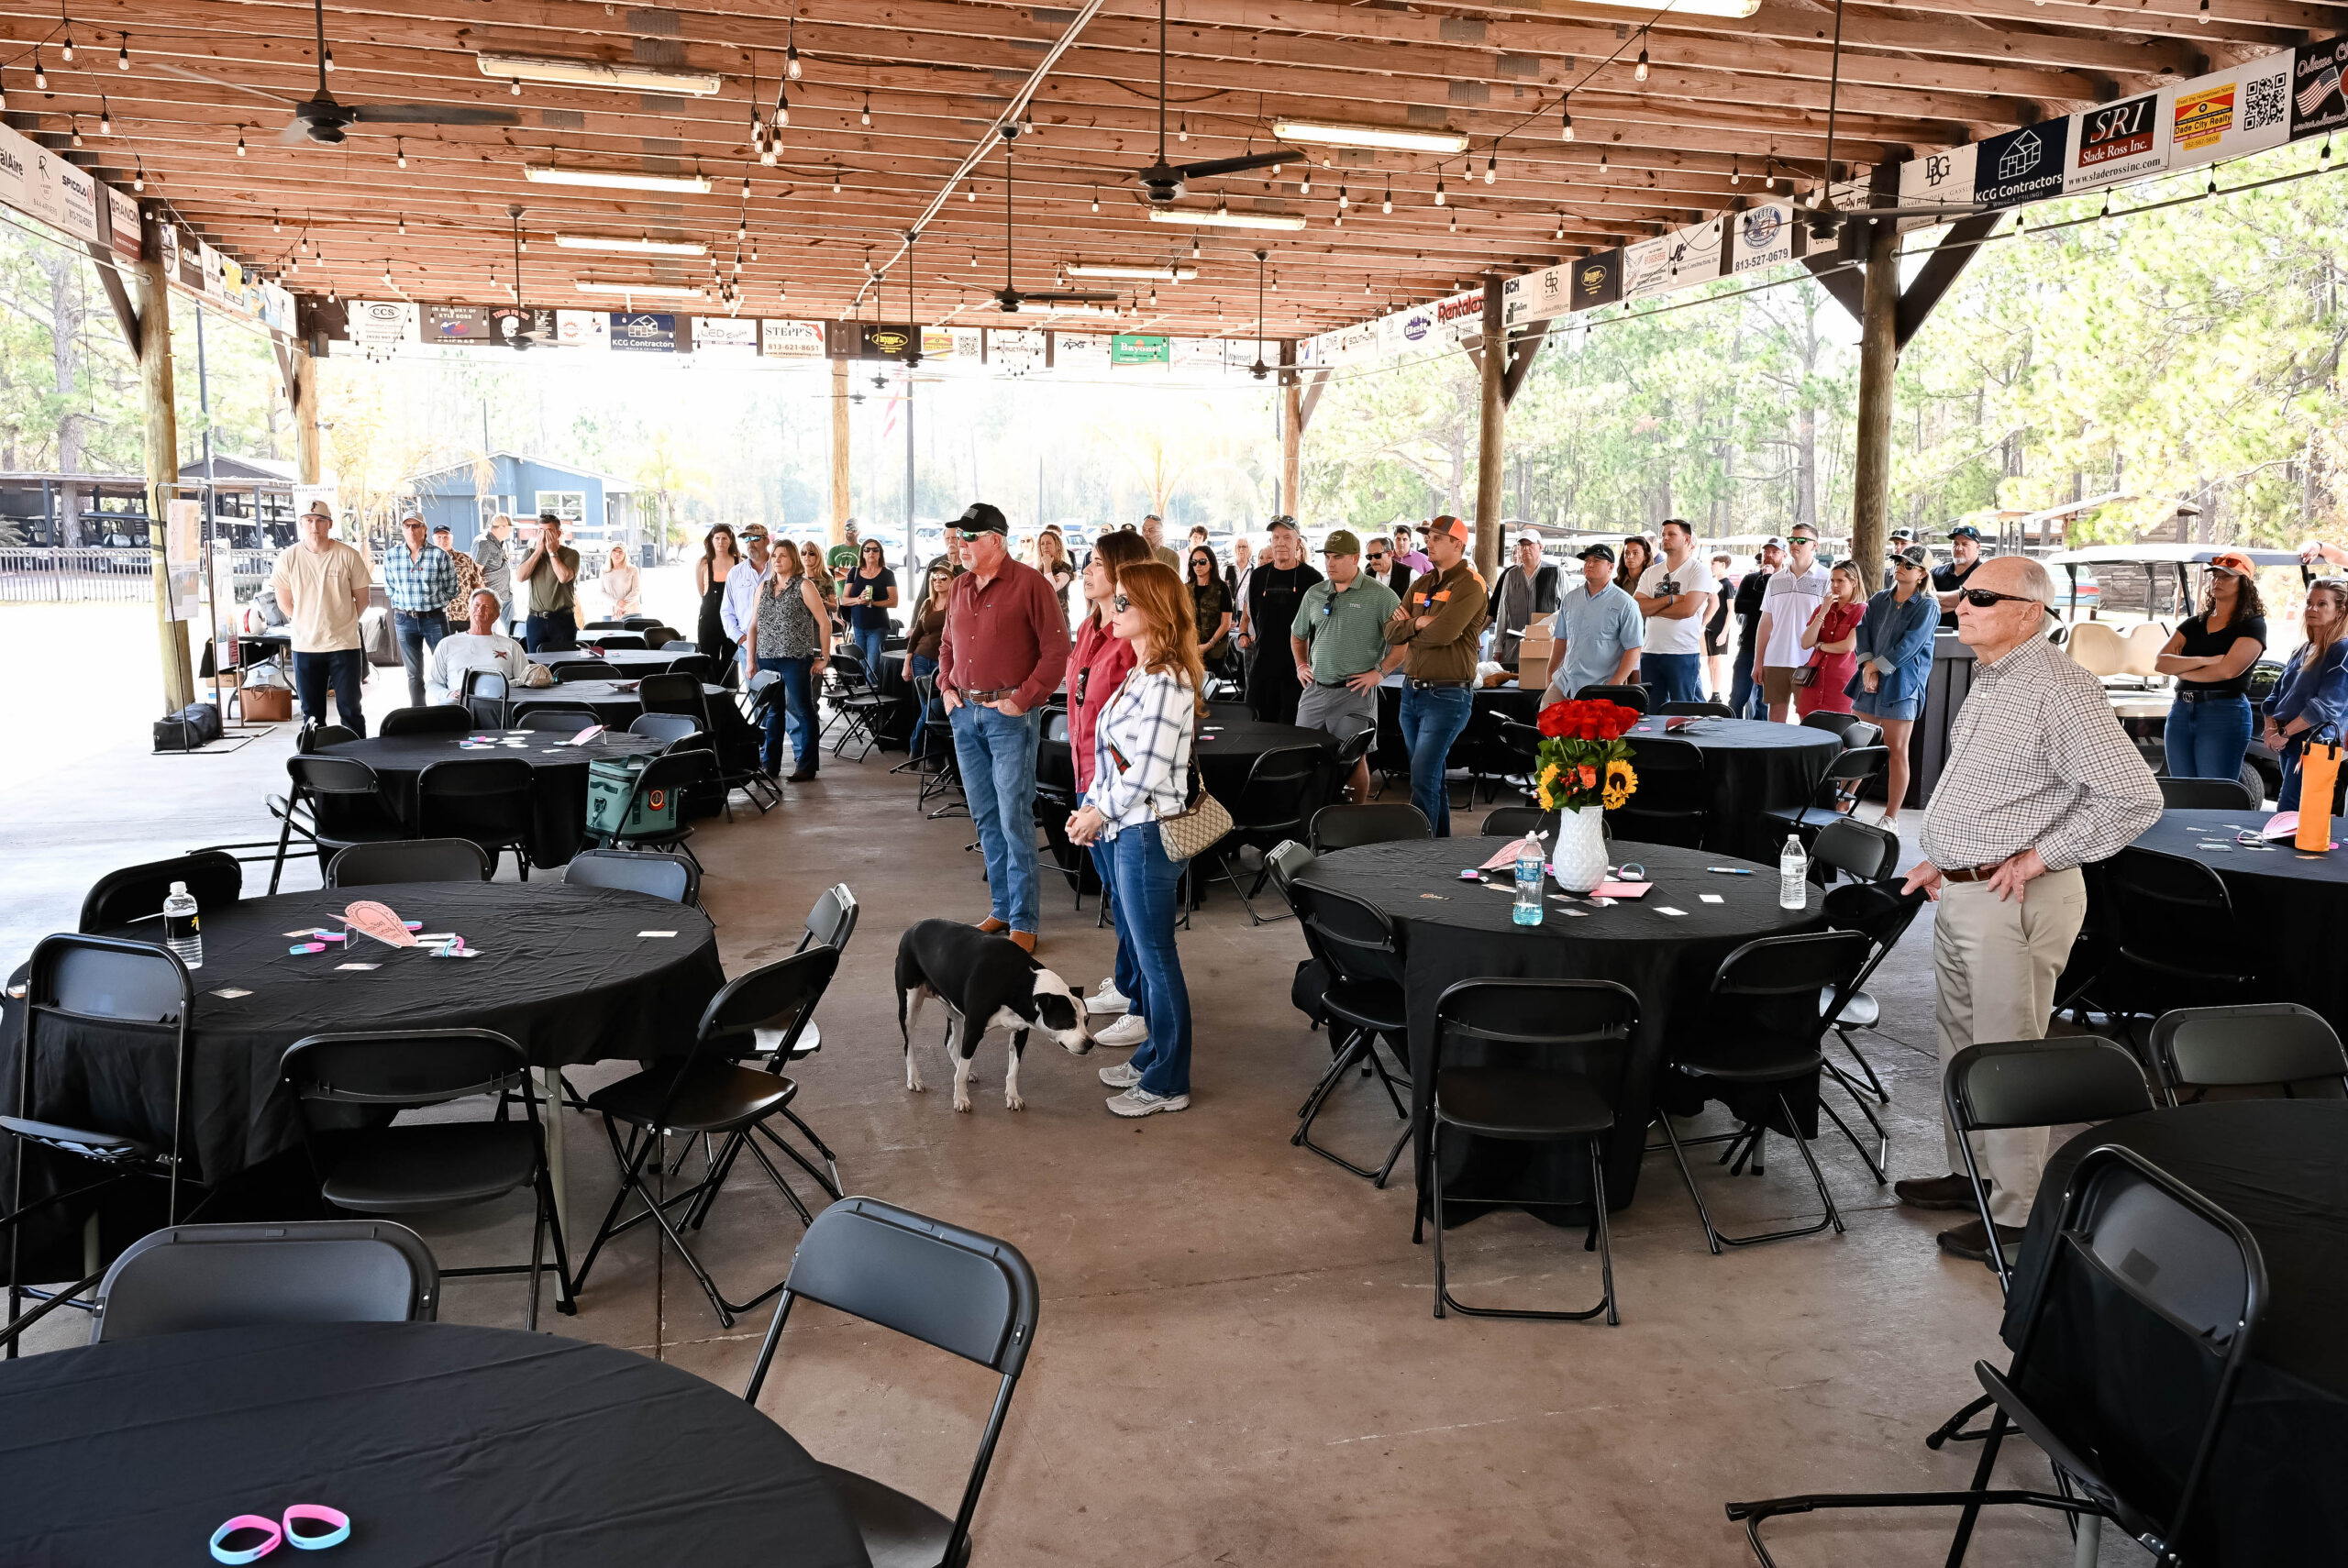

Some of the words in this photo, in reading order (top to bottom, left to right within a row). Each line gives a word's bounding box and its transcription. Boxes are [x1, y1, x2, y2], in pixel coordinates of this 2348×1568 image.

[2297, 54, 2333, 77] Odessa
[2090, 101, 2149, 143] SRI
[2175, 125, 2192, 135] Dade
[2194, 120, 2208, 129] City
[2210, 114, 2232, 126] Realty
[2082, 148, 2106, 164] Slade
[2107, 144, 2128, 158] Ross
[2130, 139, 2147, 153] Inc.
[2068, 158, 2161, 186] www.sladerossinc.com
[1975, 187, 1997, 203] KCG
[1999, 173, 2063, 197] Contractors
[1735, 248, 1789, 271] 813-527-0679
[1504, 279, 1520, 295] BCH
[765, 326, 813, 337] STEPP'S
[629, 339, 675, 348] Contractors
[768, 343, 819, 351] 813-621-8651
[1120, 342, 1162, 354] Bayonet
[1227, 352, 1252, 361] Walmart
